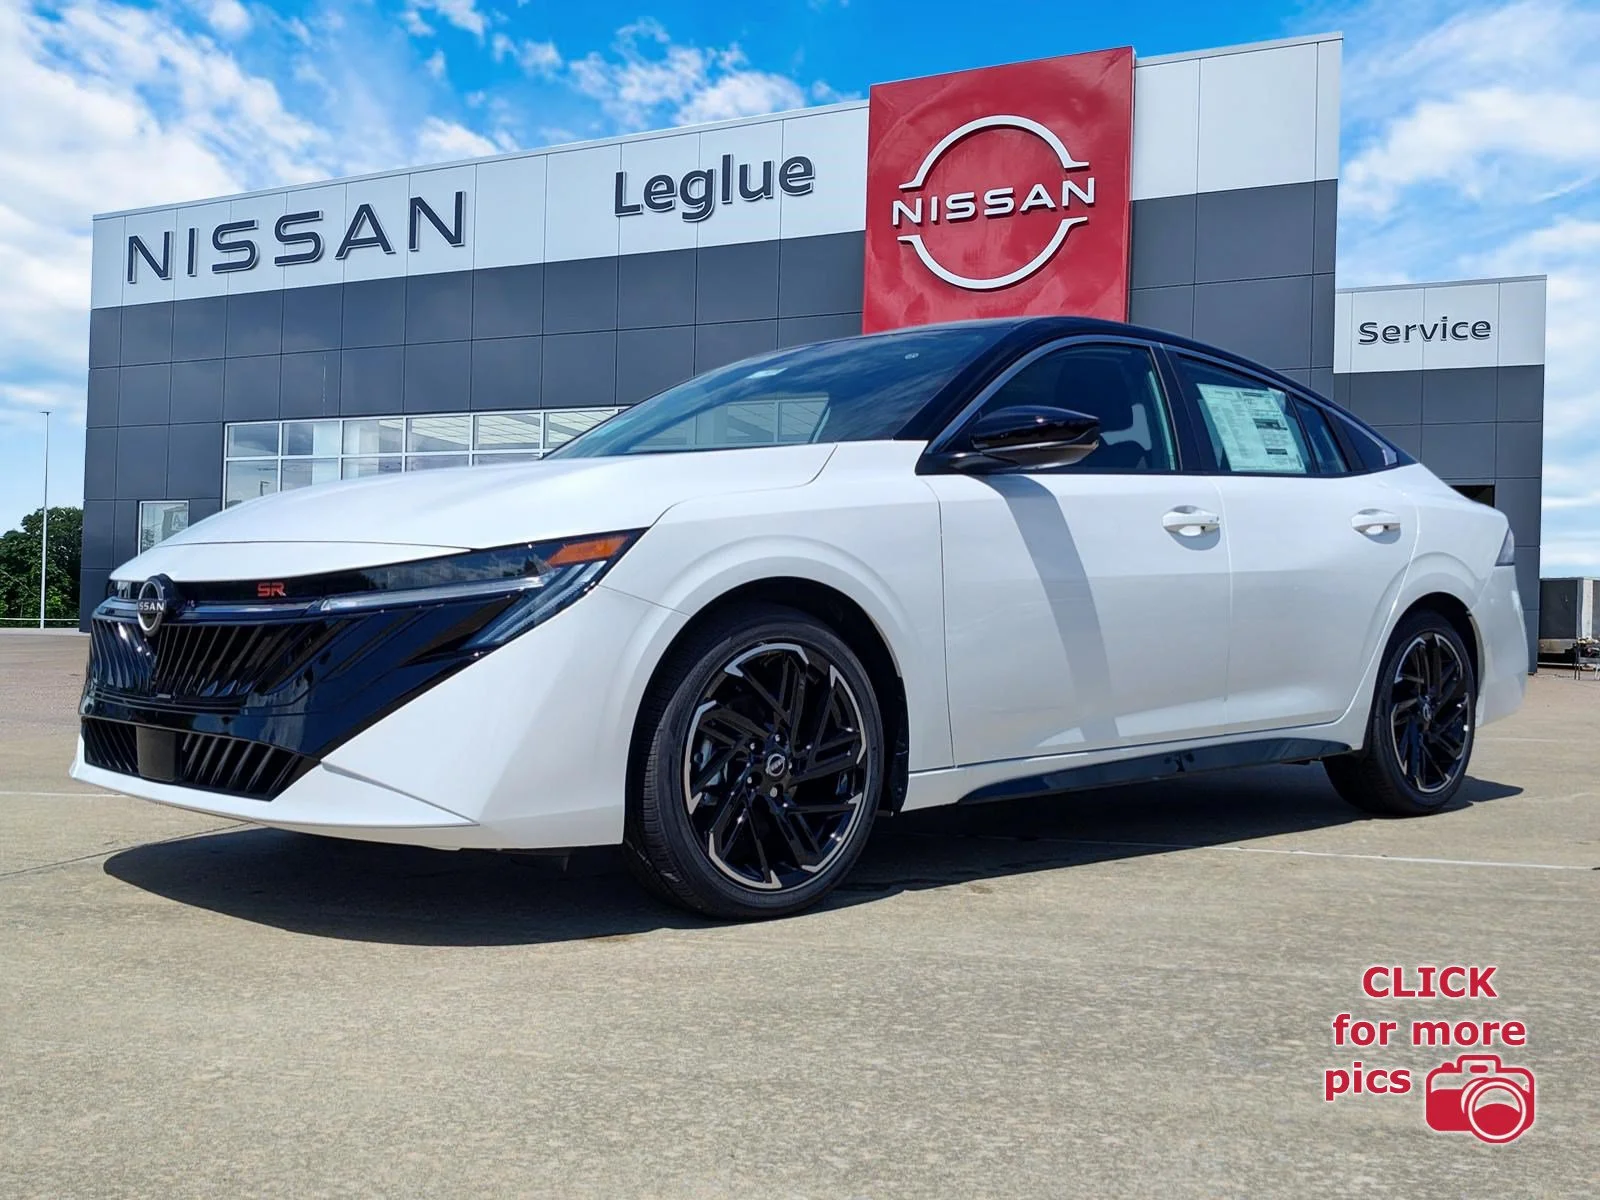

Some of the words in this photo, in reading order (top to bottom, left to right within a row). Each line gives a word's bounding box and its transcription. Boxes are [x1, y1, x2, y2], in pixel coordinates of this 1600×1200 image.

[614, 153, 815, 223] Leglue
[892, 177, 1095, 227] NISSAN
[127, 190, 466, 283] NISSAN
[1358, 316, 1492, 345] Service
[257, 582, 287, 597] SR
